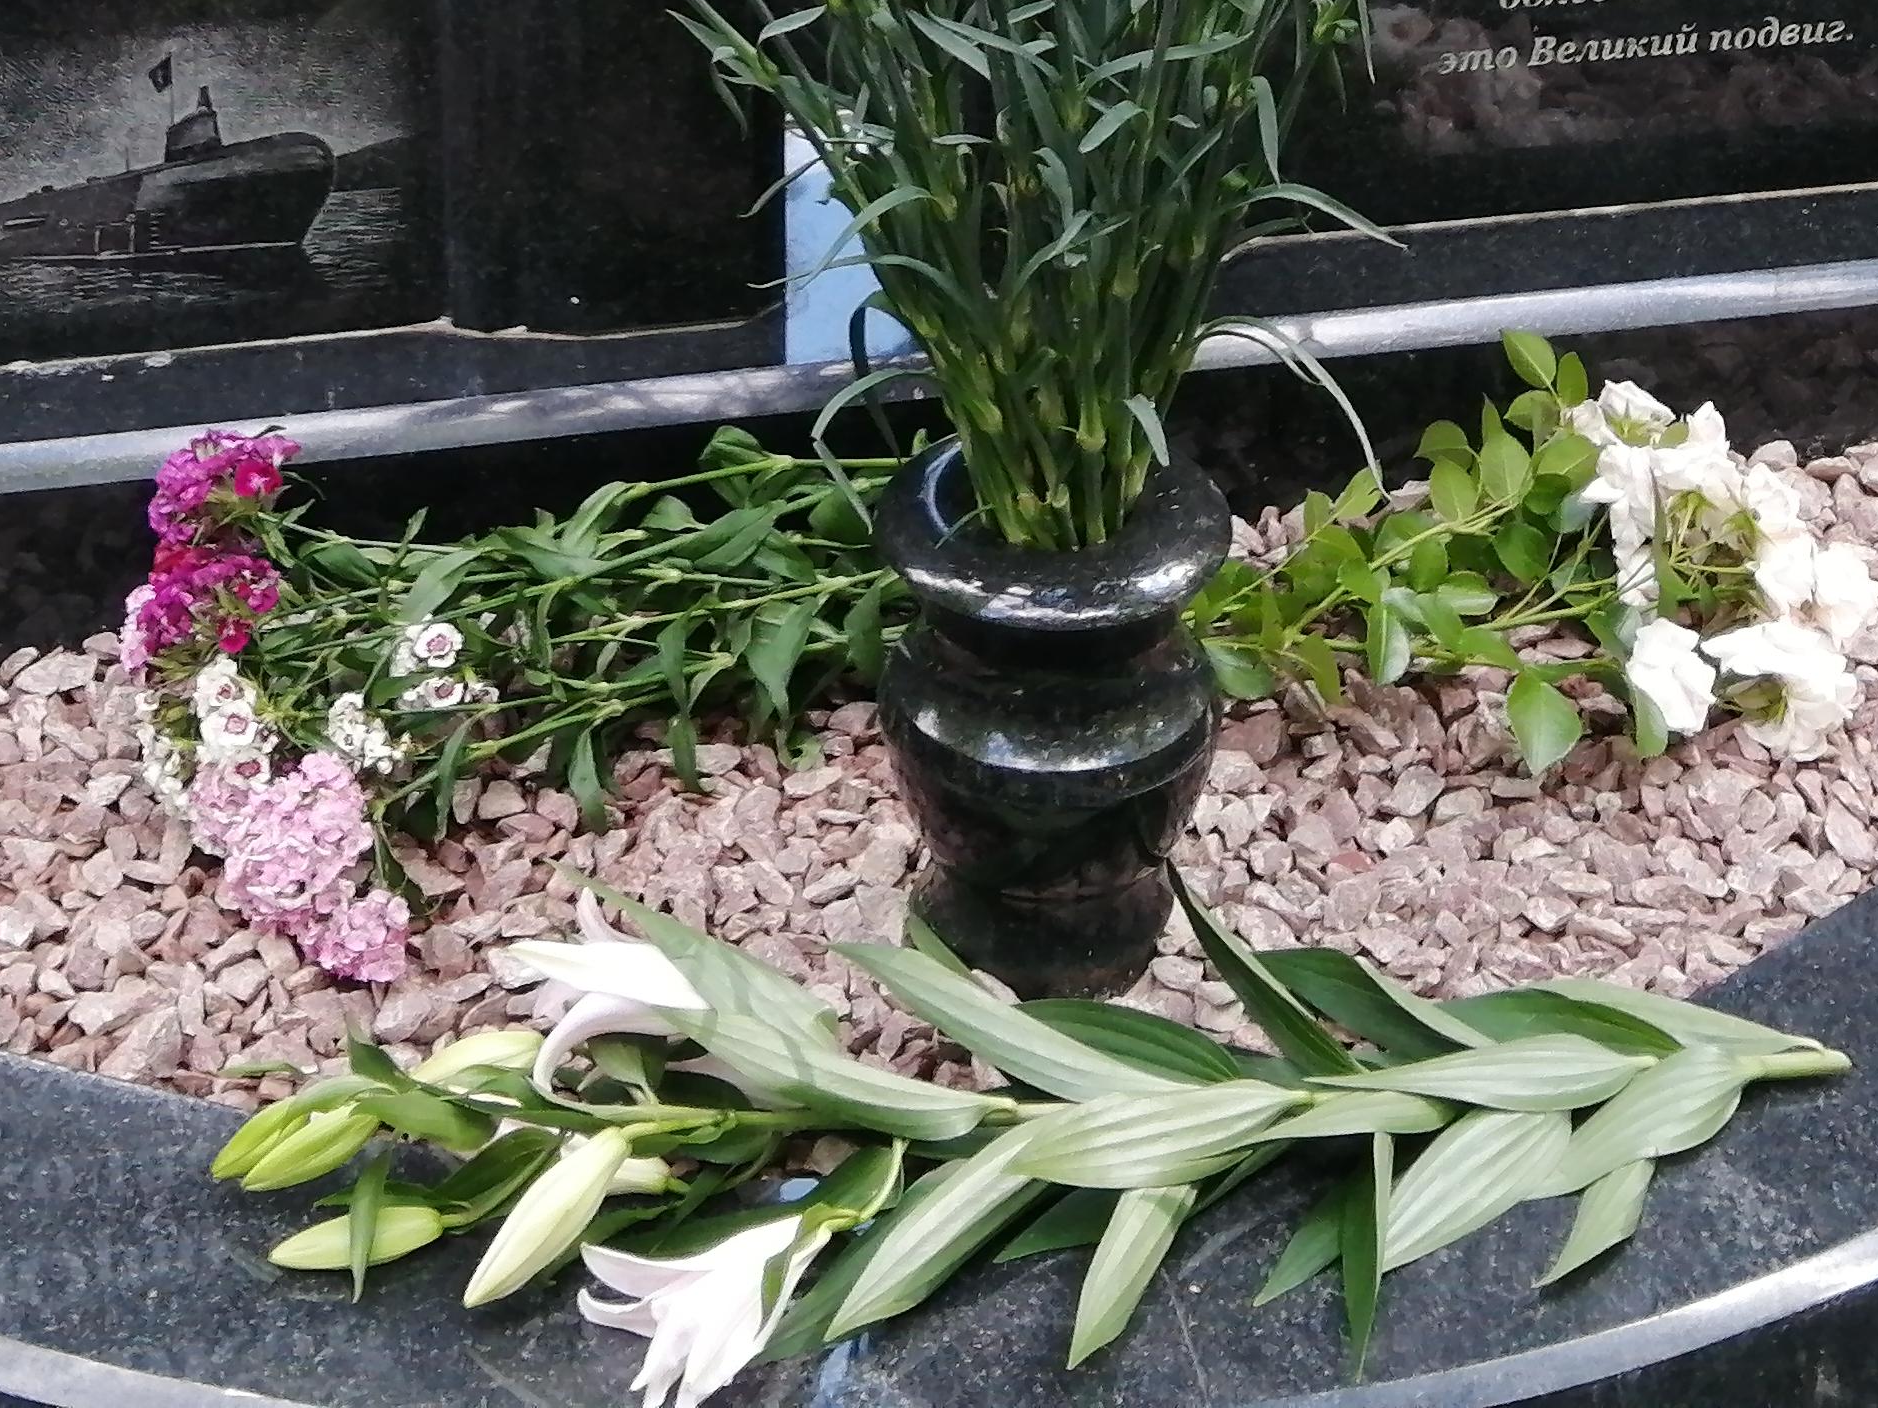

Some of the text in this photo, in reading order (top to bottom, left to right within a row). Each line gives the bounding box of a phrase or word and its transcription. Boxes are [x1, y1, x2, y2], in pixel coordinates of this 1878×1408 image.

[1436, 15, 1856, 76] это Великий подвиг.
